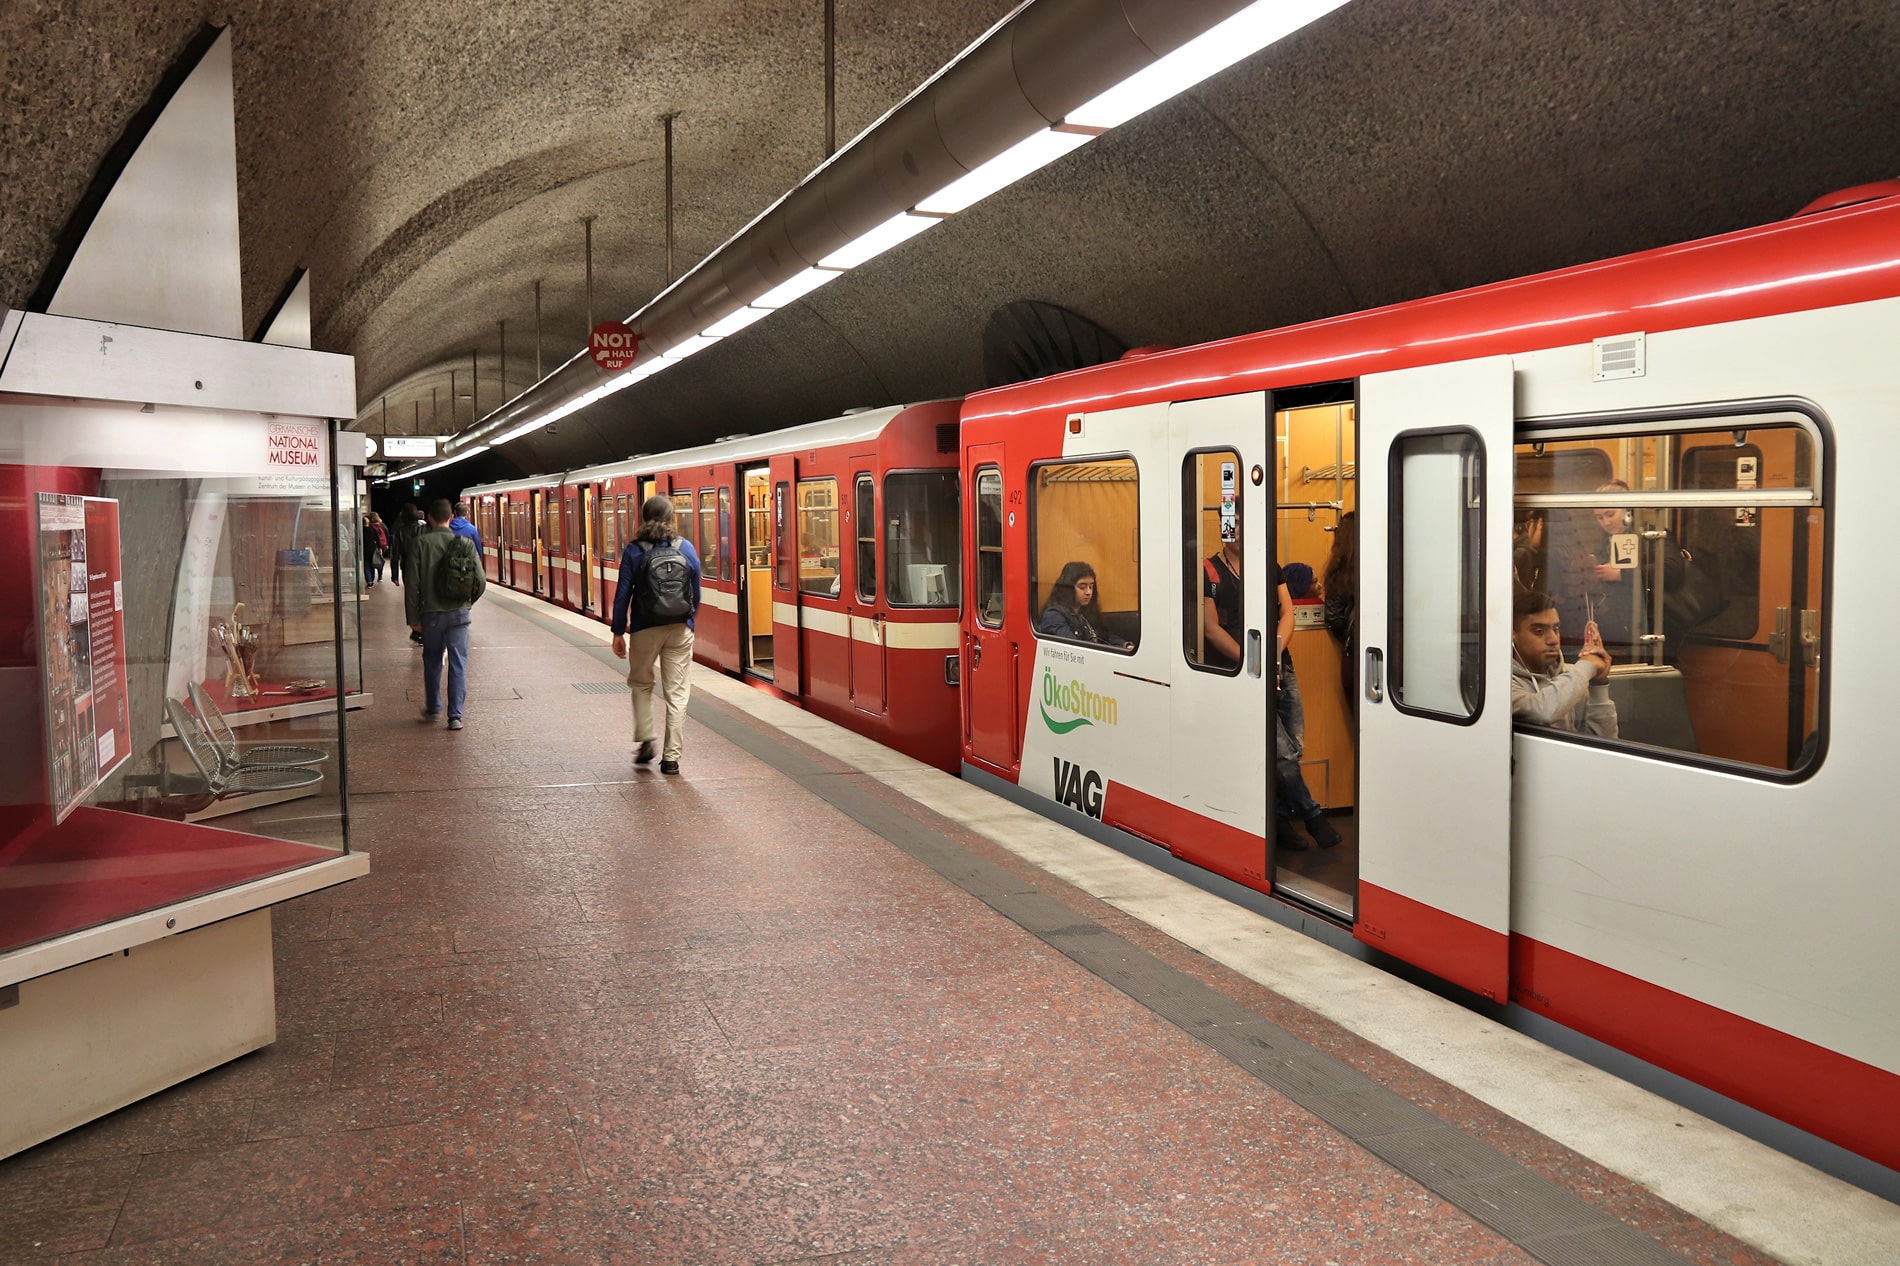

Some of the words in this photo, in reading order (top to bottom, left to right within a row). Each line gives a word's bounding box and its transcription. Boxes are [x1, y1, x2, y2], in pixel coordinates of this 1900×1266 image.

[593, 333, 633, 348] NOT
[612, 350, 634, 358] HALT
[606, 360, 623, 368] RUF
[269, 424, 319, 435] GERMANISCHES
[269, 436, 318, 449] NATIONAL
[269, 450, 318, 465] MUSEUM
[1009, 490, 1022, 505] 492
[1051, 648, 1063, 659] fahren
[1077, 655, 1085, 665] mit
[1043, 666, 1118, 726] ÖkoStrom
[1053, 756, 1103, 820] VAG
